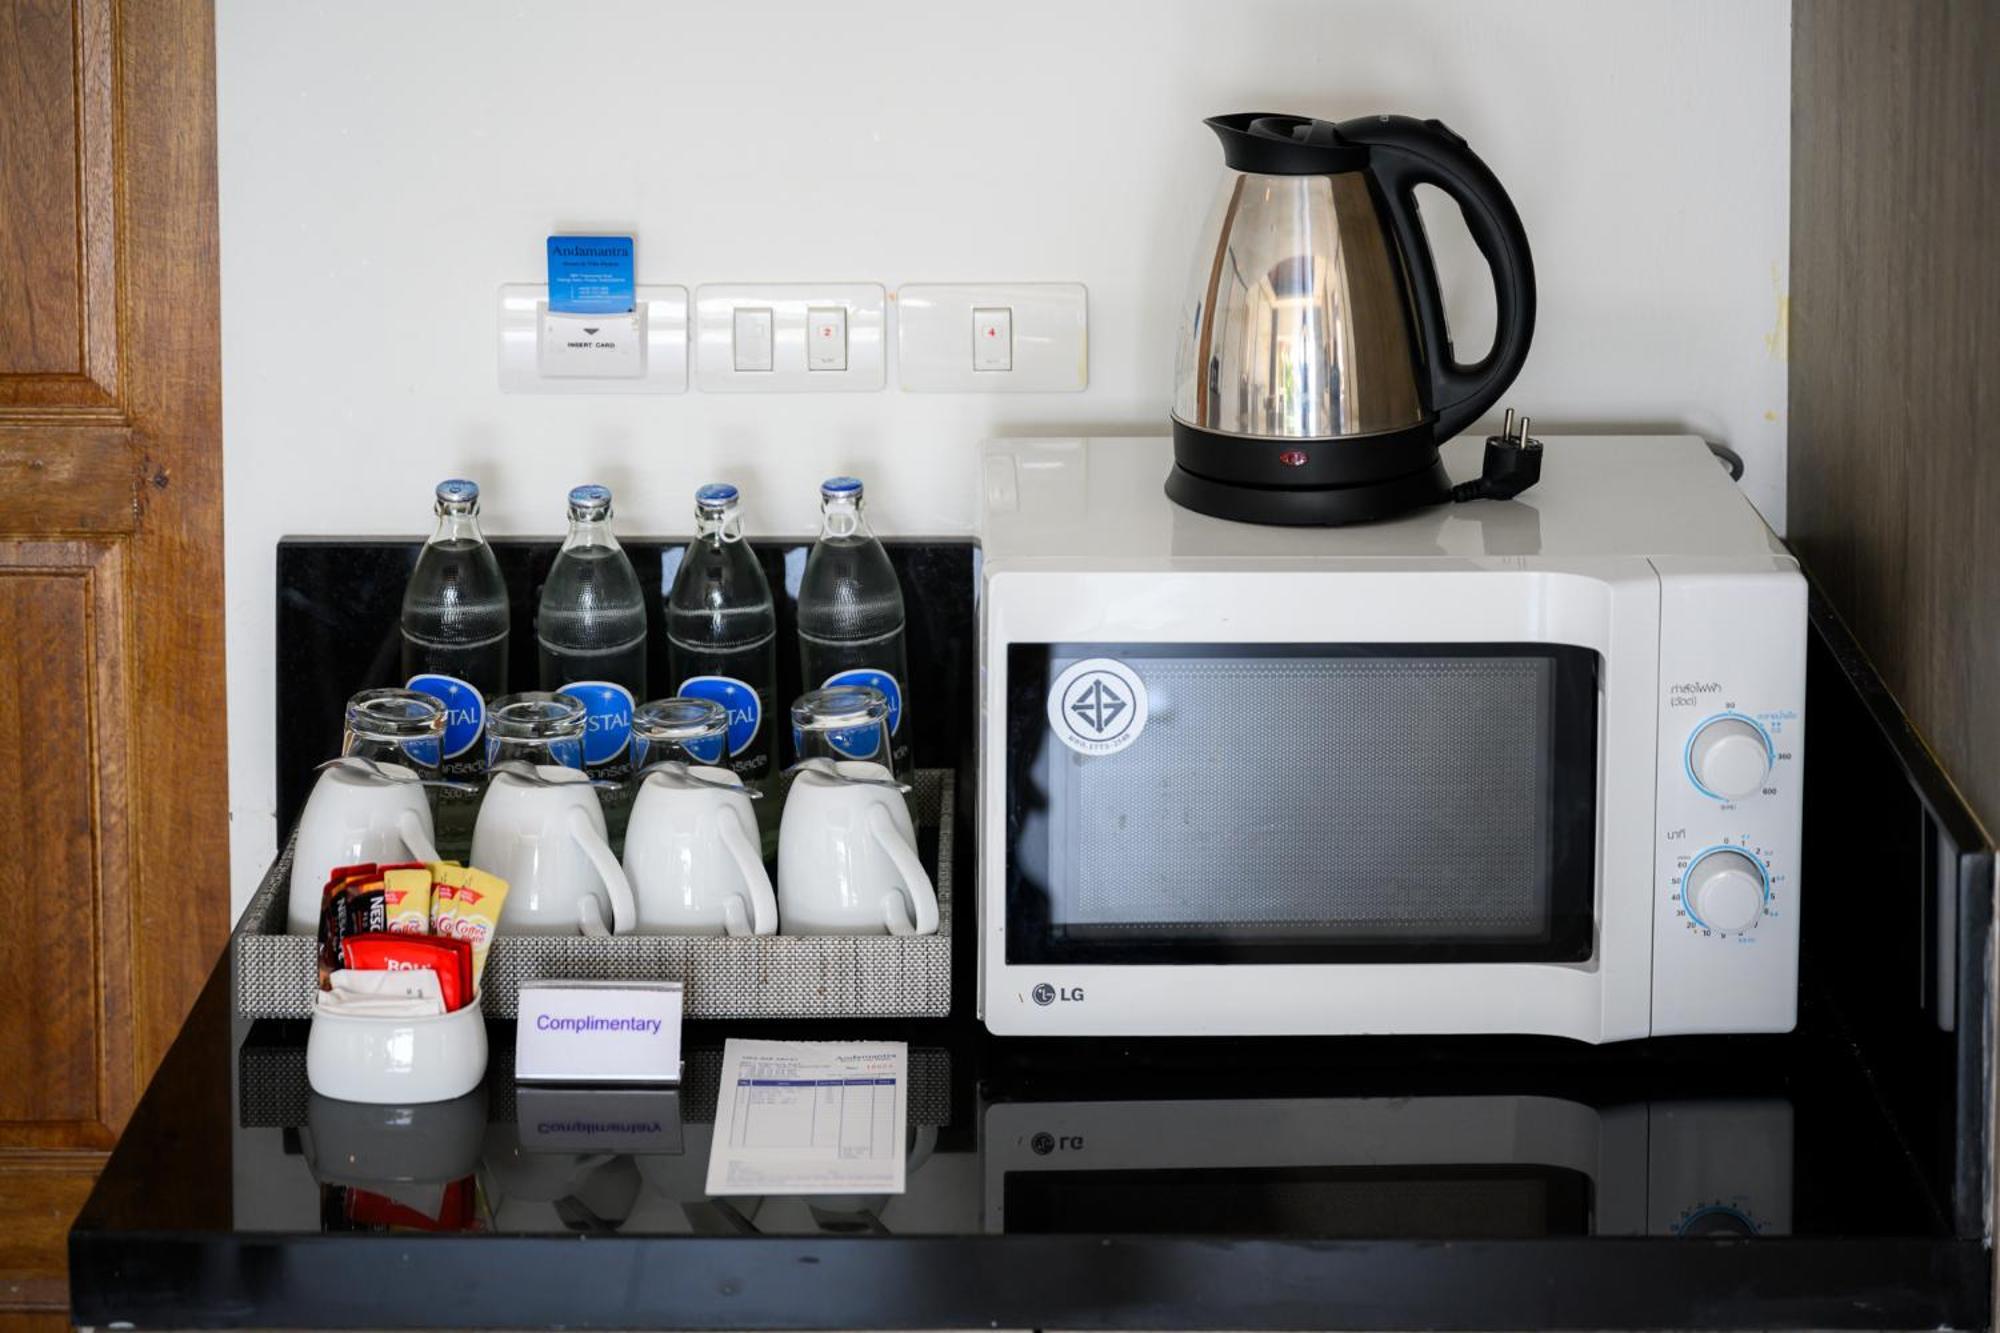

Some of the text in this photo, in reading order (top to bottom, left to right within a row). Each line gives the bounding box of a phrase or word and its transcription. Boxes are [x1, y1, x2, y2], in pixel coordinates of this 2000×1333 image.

[553, 245, 629, 256] Andamantra
[824, 328, 831, 336] 2
[988, 327, 996, 336] 4
[588, 711, 631, 730] STAL
[370, 896, 384, 932] NESC
[1061, 988, 1084, 1001] LG
[537, 1013, 661, 1035] Complimentary
